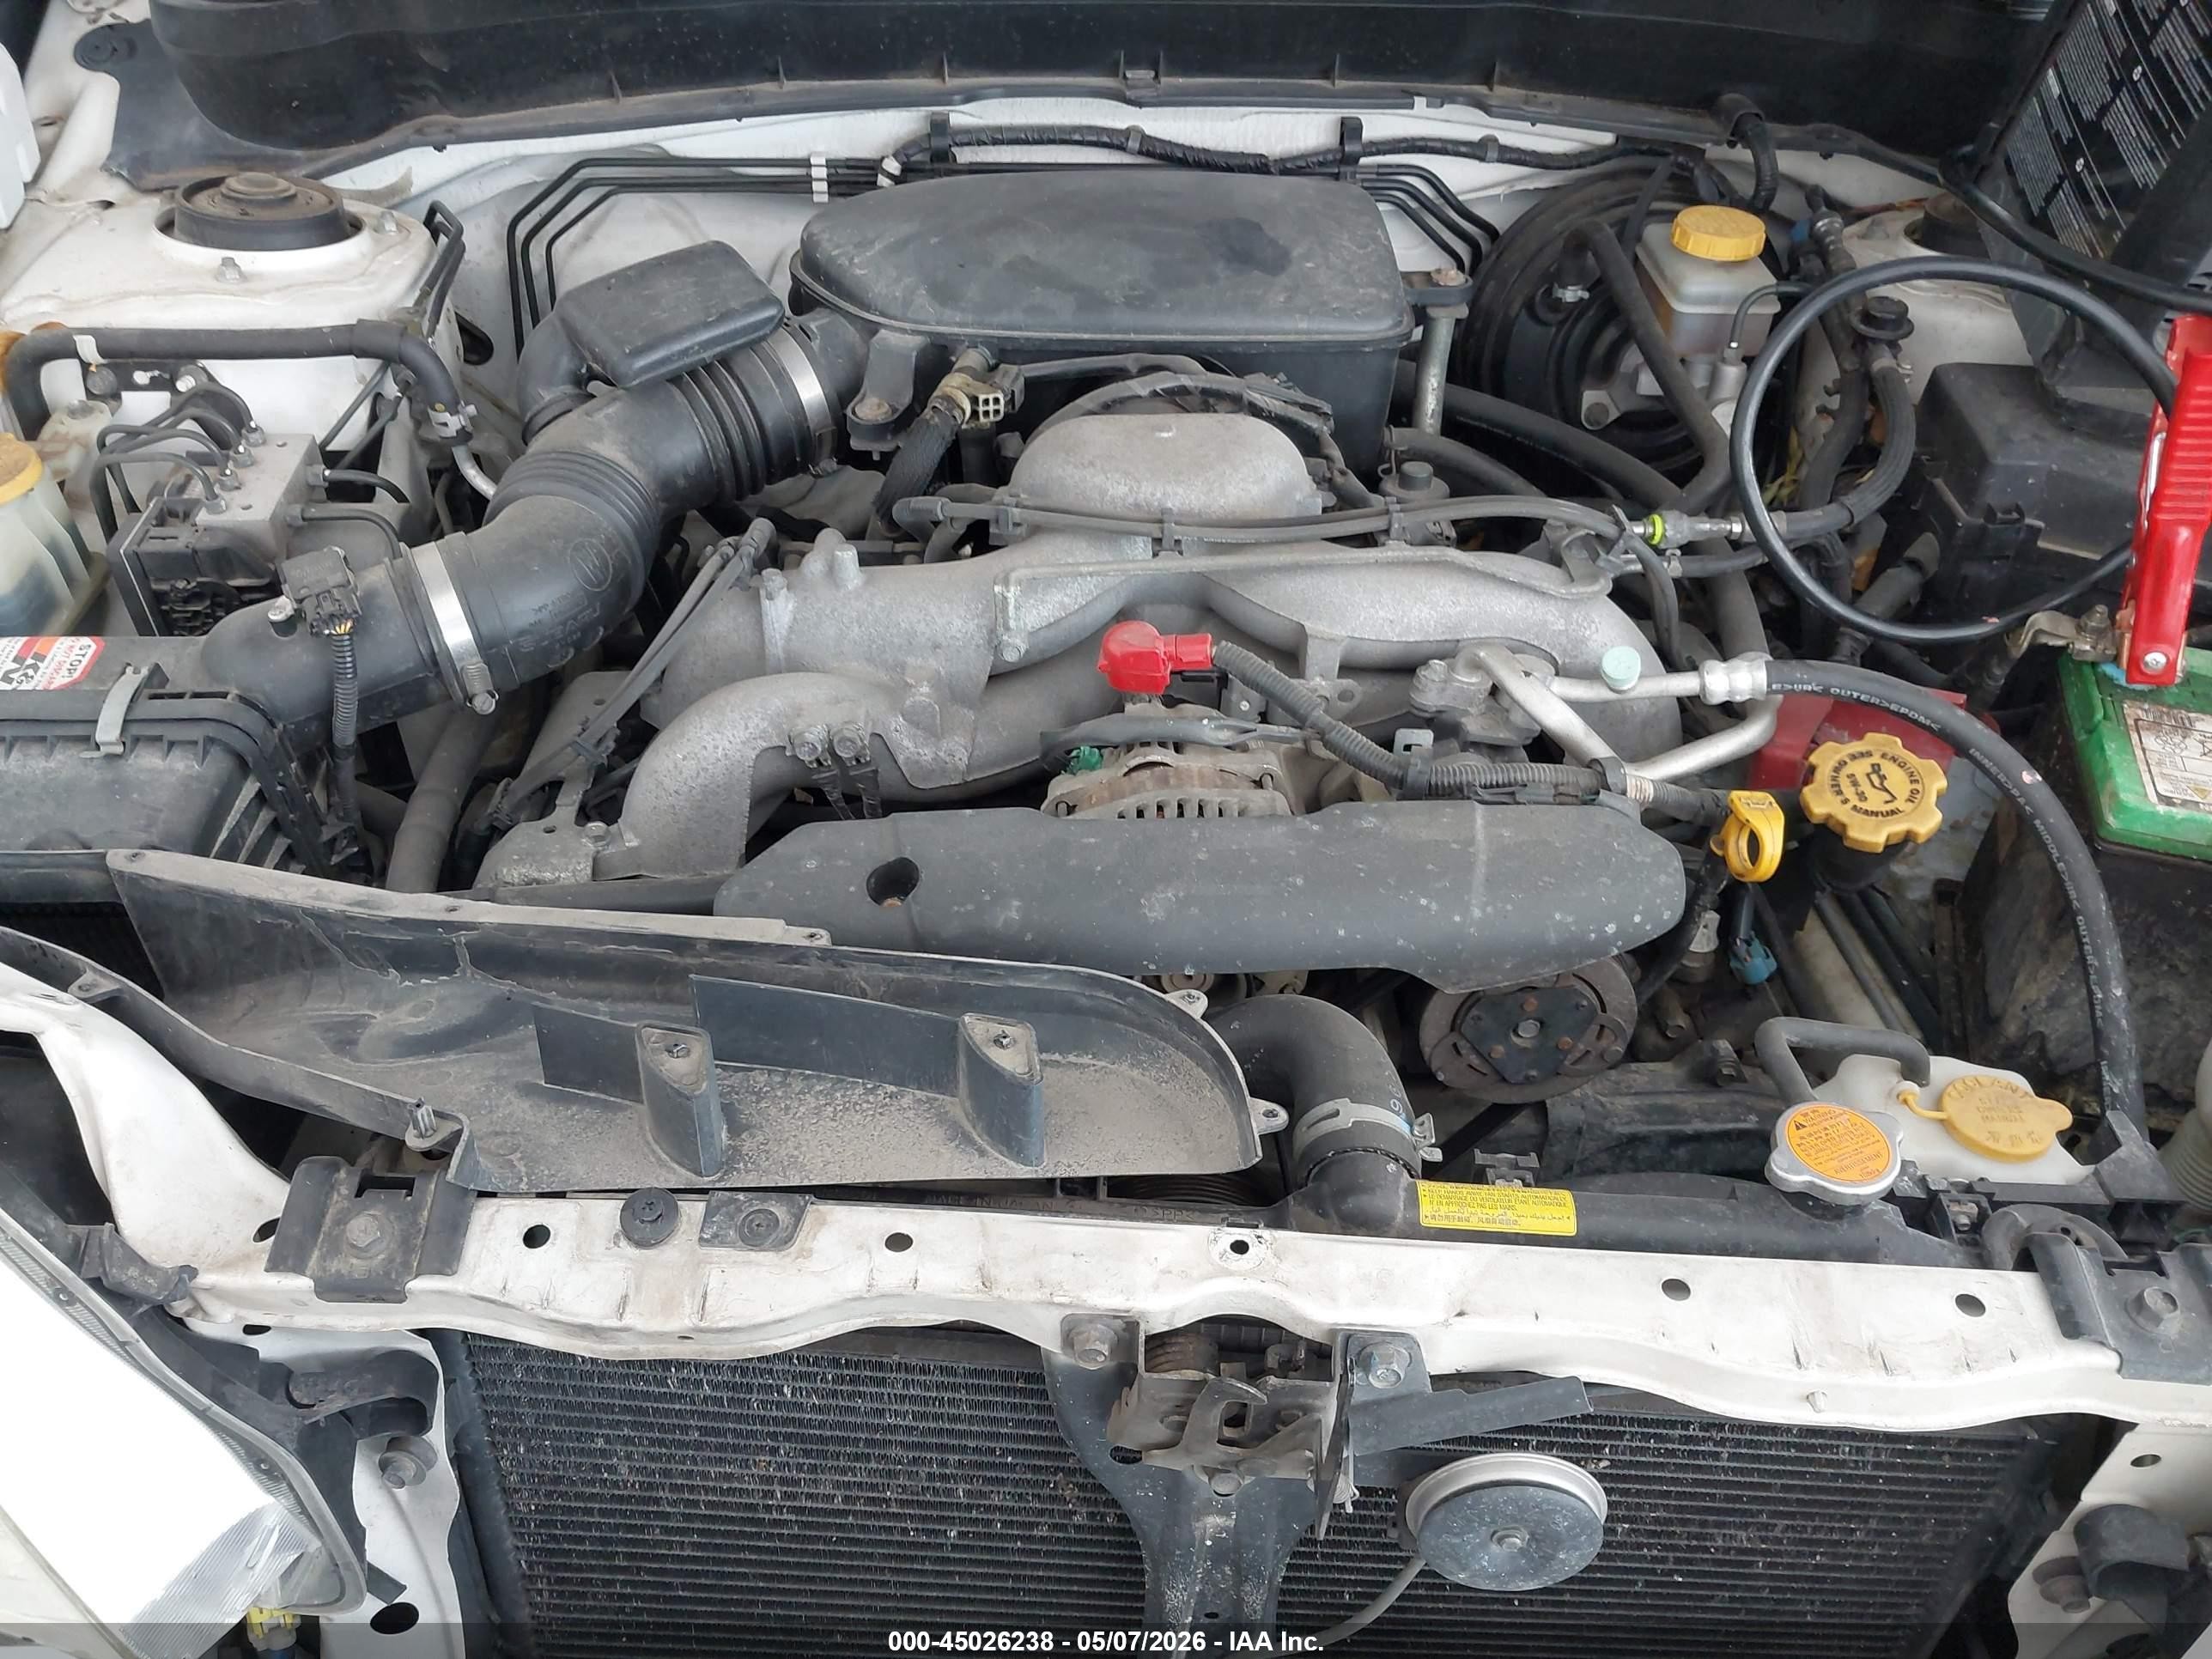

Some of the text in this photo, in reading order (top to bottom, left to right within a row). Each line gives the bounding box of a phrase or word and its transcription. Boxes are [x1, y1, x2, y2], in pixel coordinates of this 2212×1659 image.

[1881, 752, 1920, 804] ENGINE OIL
[1850, 805, 1905, 817] MANUAL
